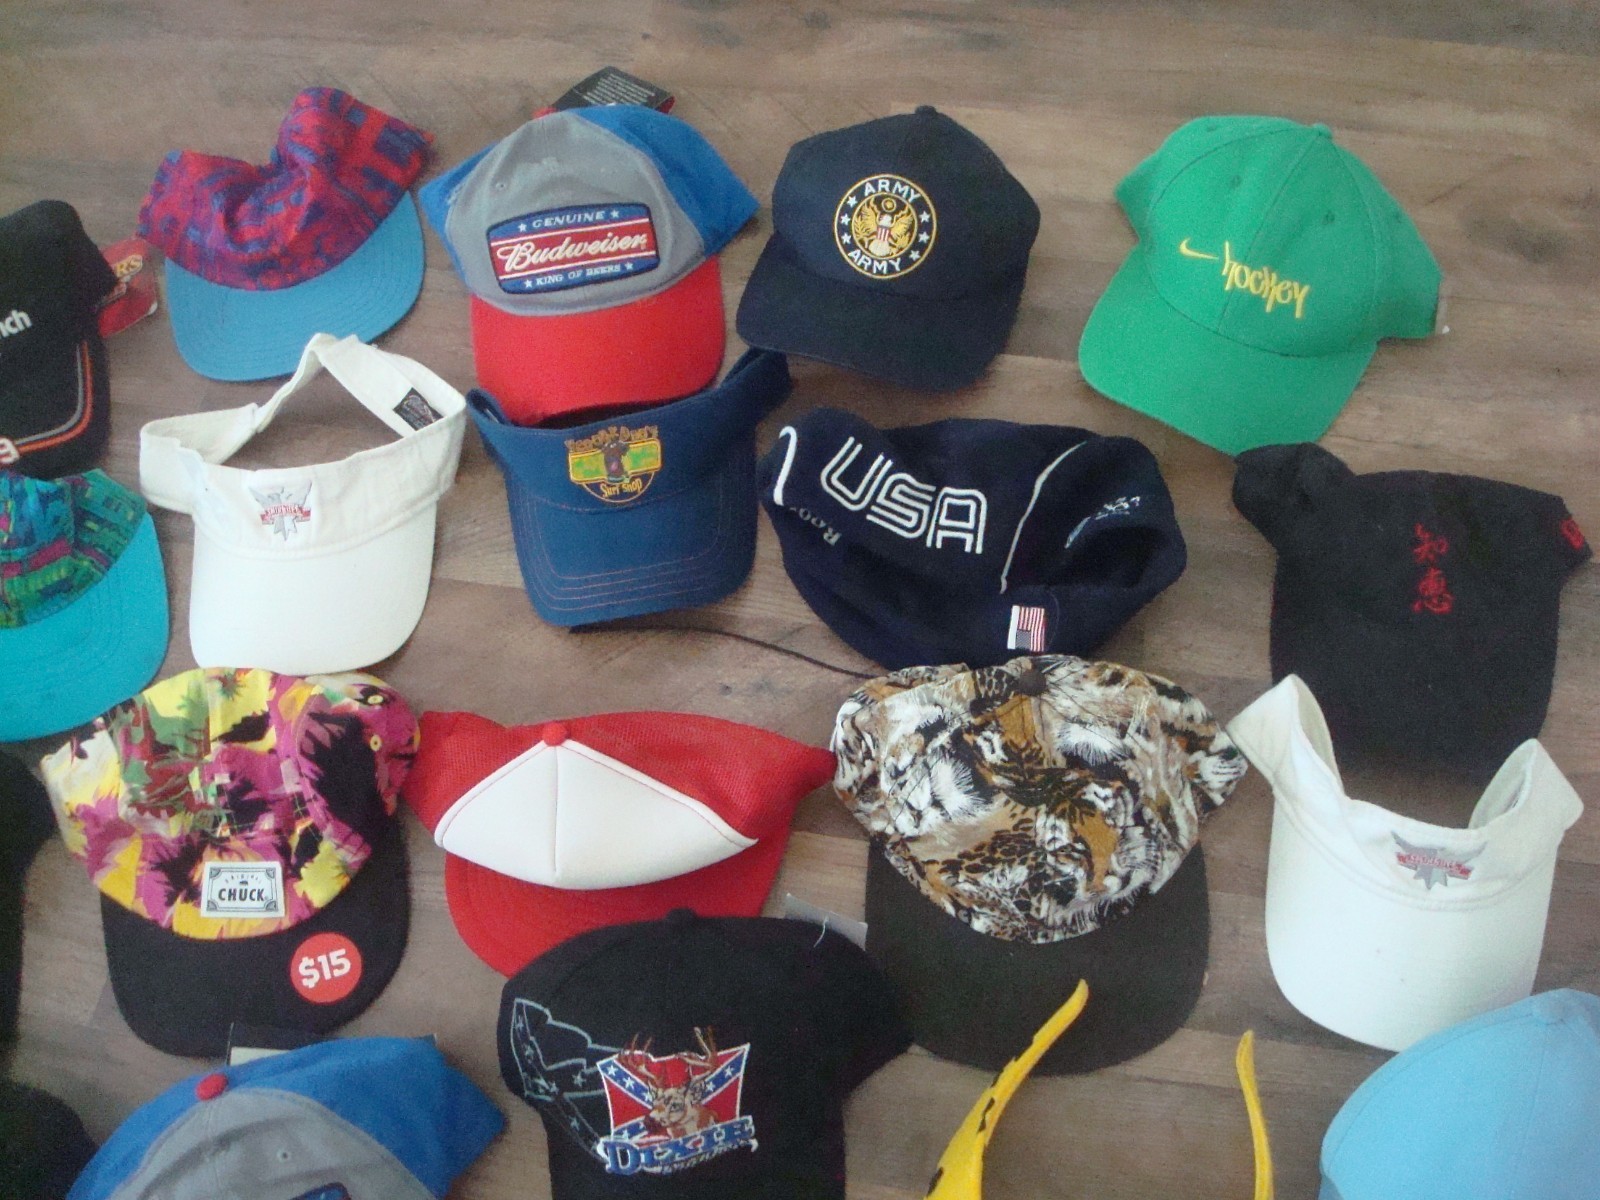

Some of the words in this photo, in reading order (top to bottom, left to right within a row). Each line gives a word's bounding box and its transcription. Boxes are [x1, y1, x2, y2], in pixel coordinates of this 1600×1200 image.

[864, 179, 920, 202] ARMY
[532, 210, 606, 227] GENUINE
[497, 232, 648, 271] Budweiser
[848, 249, 901, 273] ARMY
[536, 275, 563, 286] KING
[568, 270, 583, 279] OF
[586, 264, 621, 276] BEERS
[1222, 240, 1310, 318] hockey
[820, 436, 987, 554] USA
[218, 888, 265, 901] CHUCK
[298, 948, 351, 988] $15
